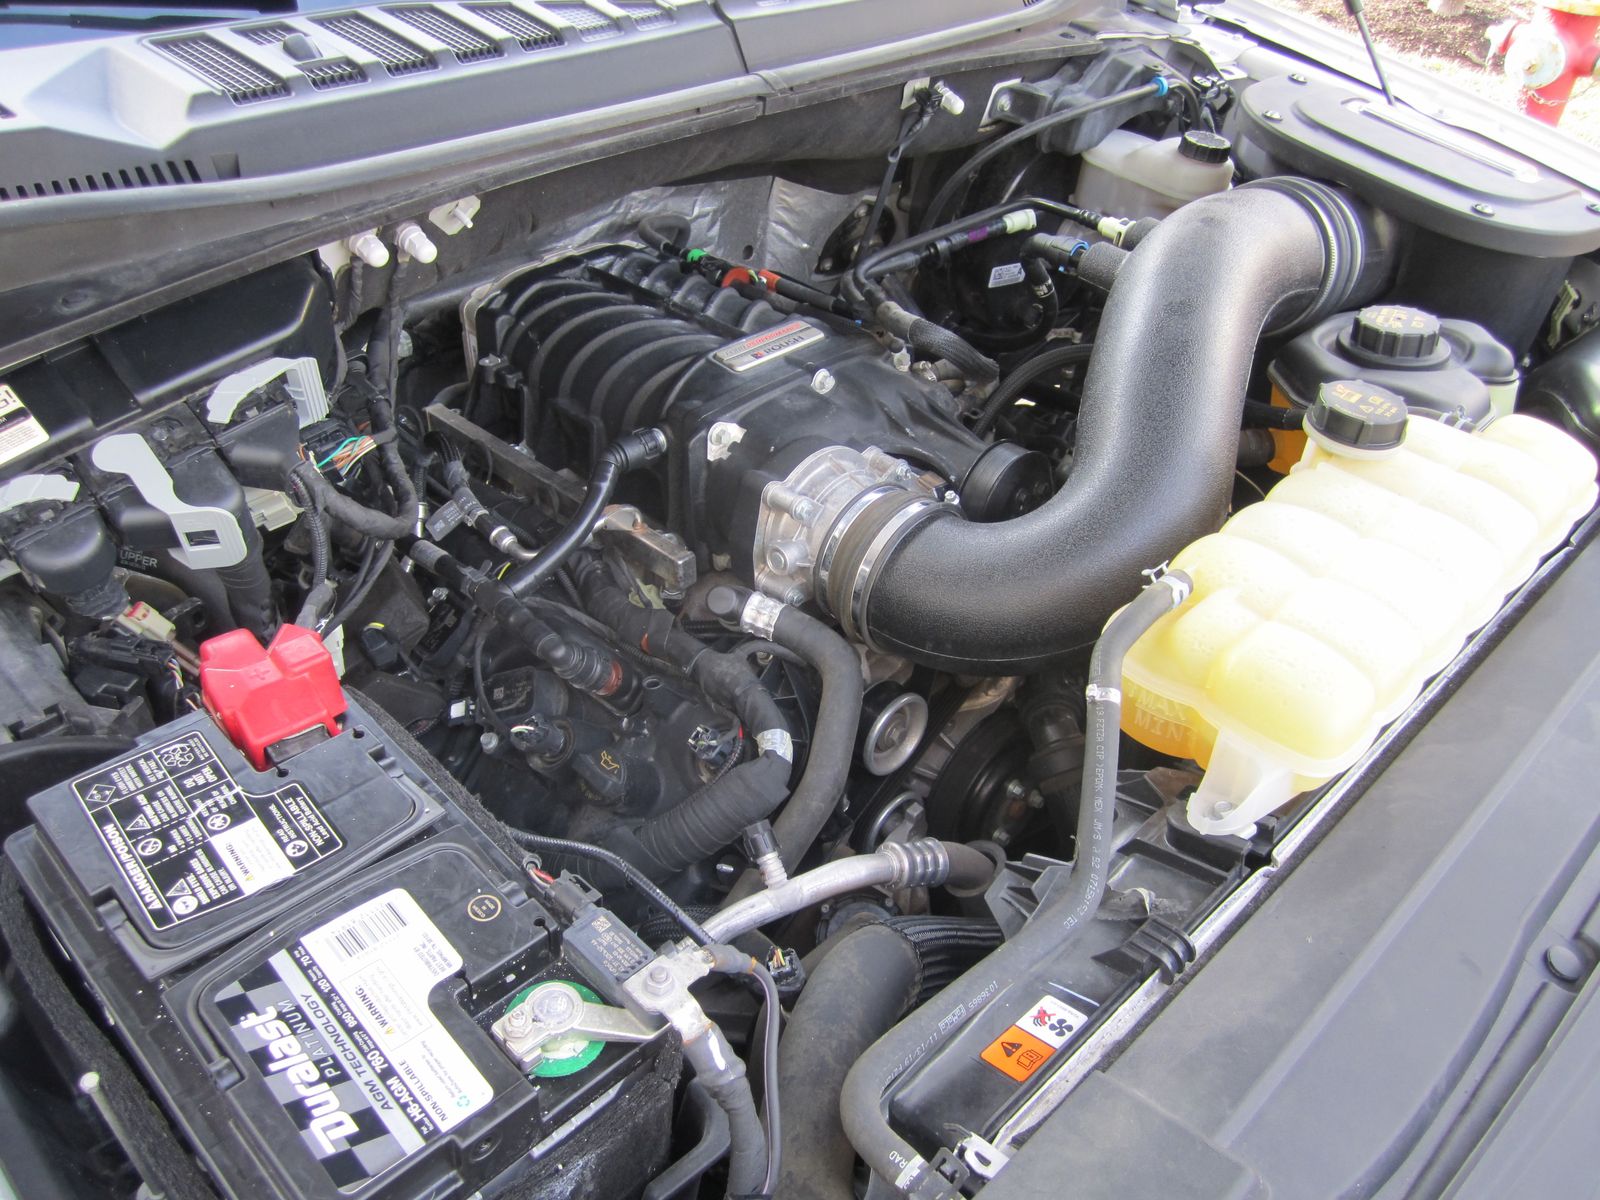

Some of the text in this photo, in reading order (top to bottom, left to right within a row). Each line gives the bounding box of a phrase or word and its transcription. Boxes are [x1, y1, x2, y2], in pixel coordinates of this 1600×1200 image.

[764, 336, 806, 354] ROUSH
[120, 549, 157, 568] UPPER
[1134, 710, 1185, 742] MIN
[283, 796, 325, 846] NON-SPILLABLE
[307, 814, 320, 826] Acid
[315, 824, 330, 839] Lead
[275, 828, 290, 842] READ
[102, 822, 158, 903] DANGER/POISON
[299, 954, 312, 966] 70
[316, 978, 331, 993] 120
[341, 1010, 357, 1028] 950
[352, 983, 388, 1028] WARNING:
[277, 997, 341, 1079] PLATINUM
[300, 994, 367, 1077] TECHNOLOGY
[365, 1048, 388, 1073] 760
[239, 1004, 360, 1154] Duralast
[397, 1058, 448, 1122] NON-SPILLABLE
[363, 1078, 393, 1108] AGM
[385, 1075, 425, 1121] H6-AGM
[888, 1150, 908, 1169] RAD
